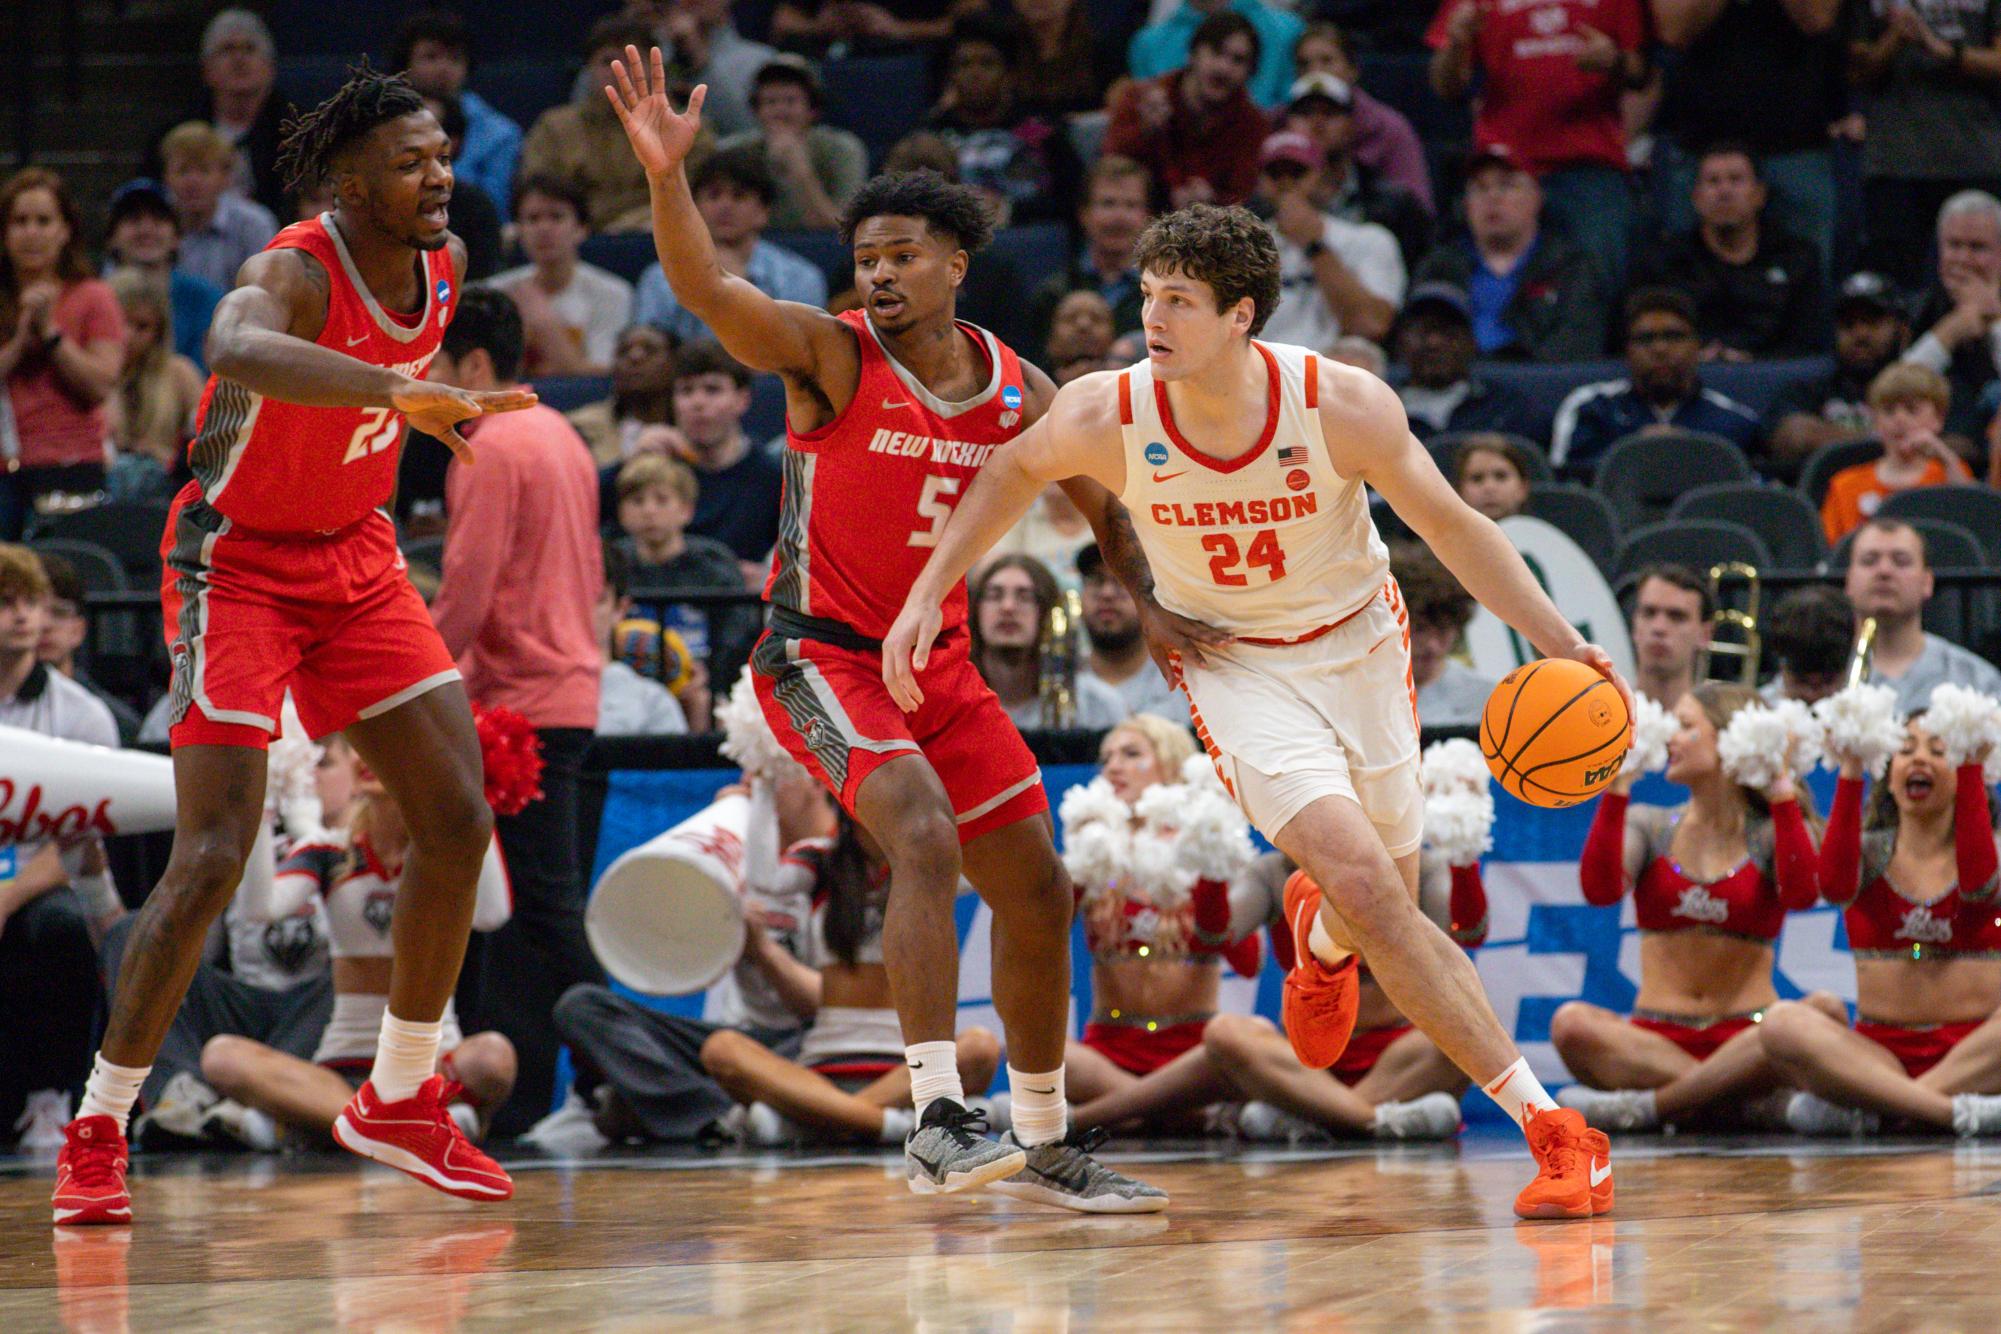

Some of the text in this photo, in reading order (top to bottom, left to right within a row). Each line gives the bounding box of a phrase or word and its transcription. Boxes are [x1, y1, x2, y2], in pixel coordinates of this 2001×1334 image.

[868, 427, 996, 468] NEW MEXIC
[906, 473, 961, 549] 5
[1151, 491, 1318, 527] CLEMSON
[1201, 528, 1287, 587] 24
